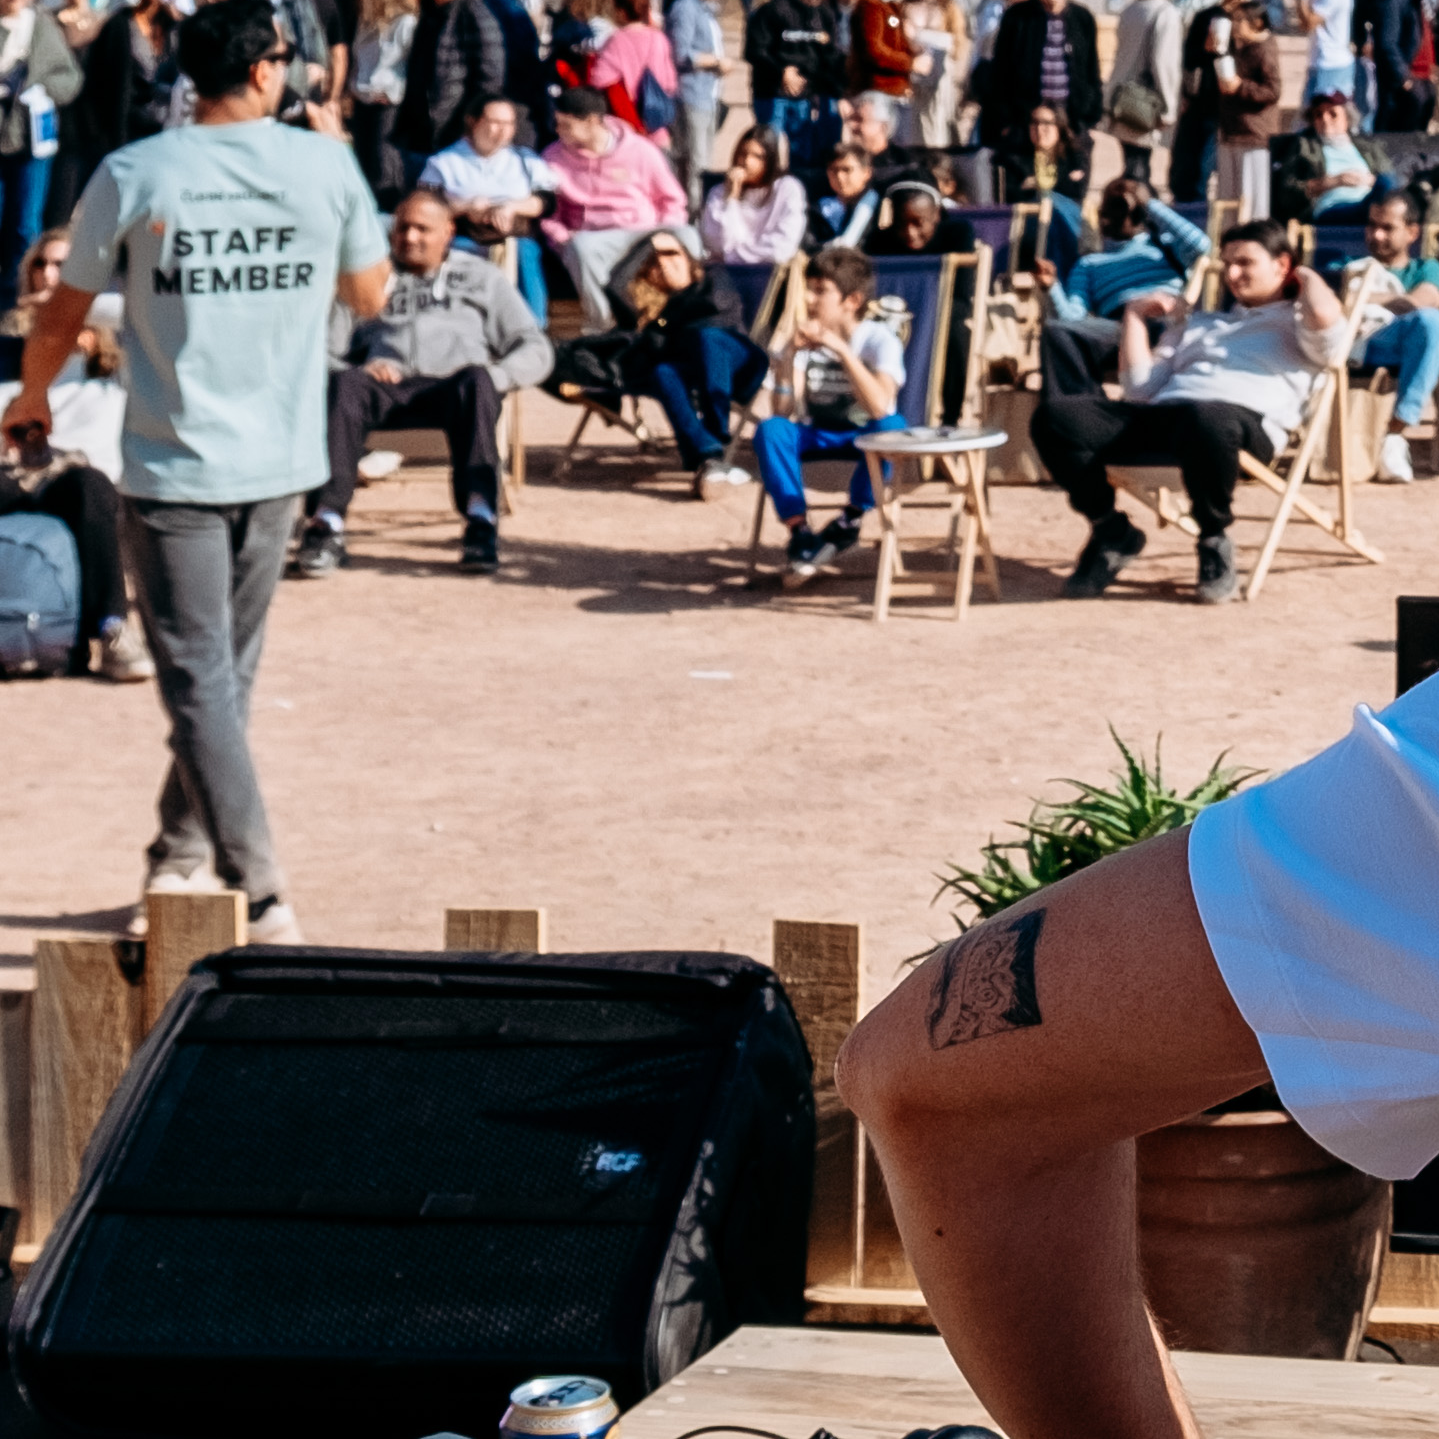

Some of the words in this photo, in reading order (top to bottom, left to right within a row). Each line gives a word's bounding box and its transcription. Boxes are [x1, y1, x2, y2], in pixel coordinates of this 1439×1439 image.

[173, 227, 296, 257] STAFF
[153, 263, 313, 294] MEMBER
[596, 1152, 641, 1172] RCF
